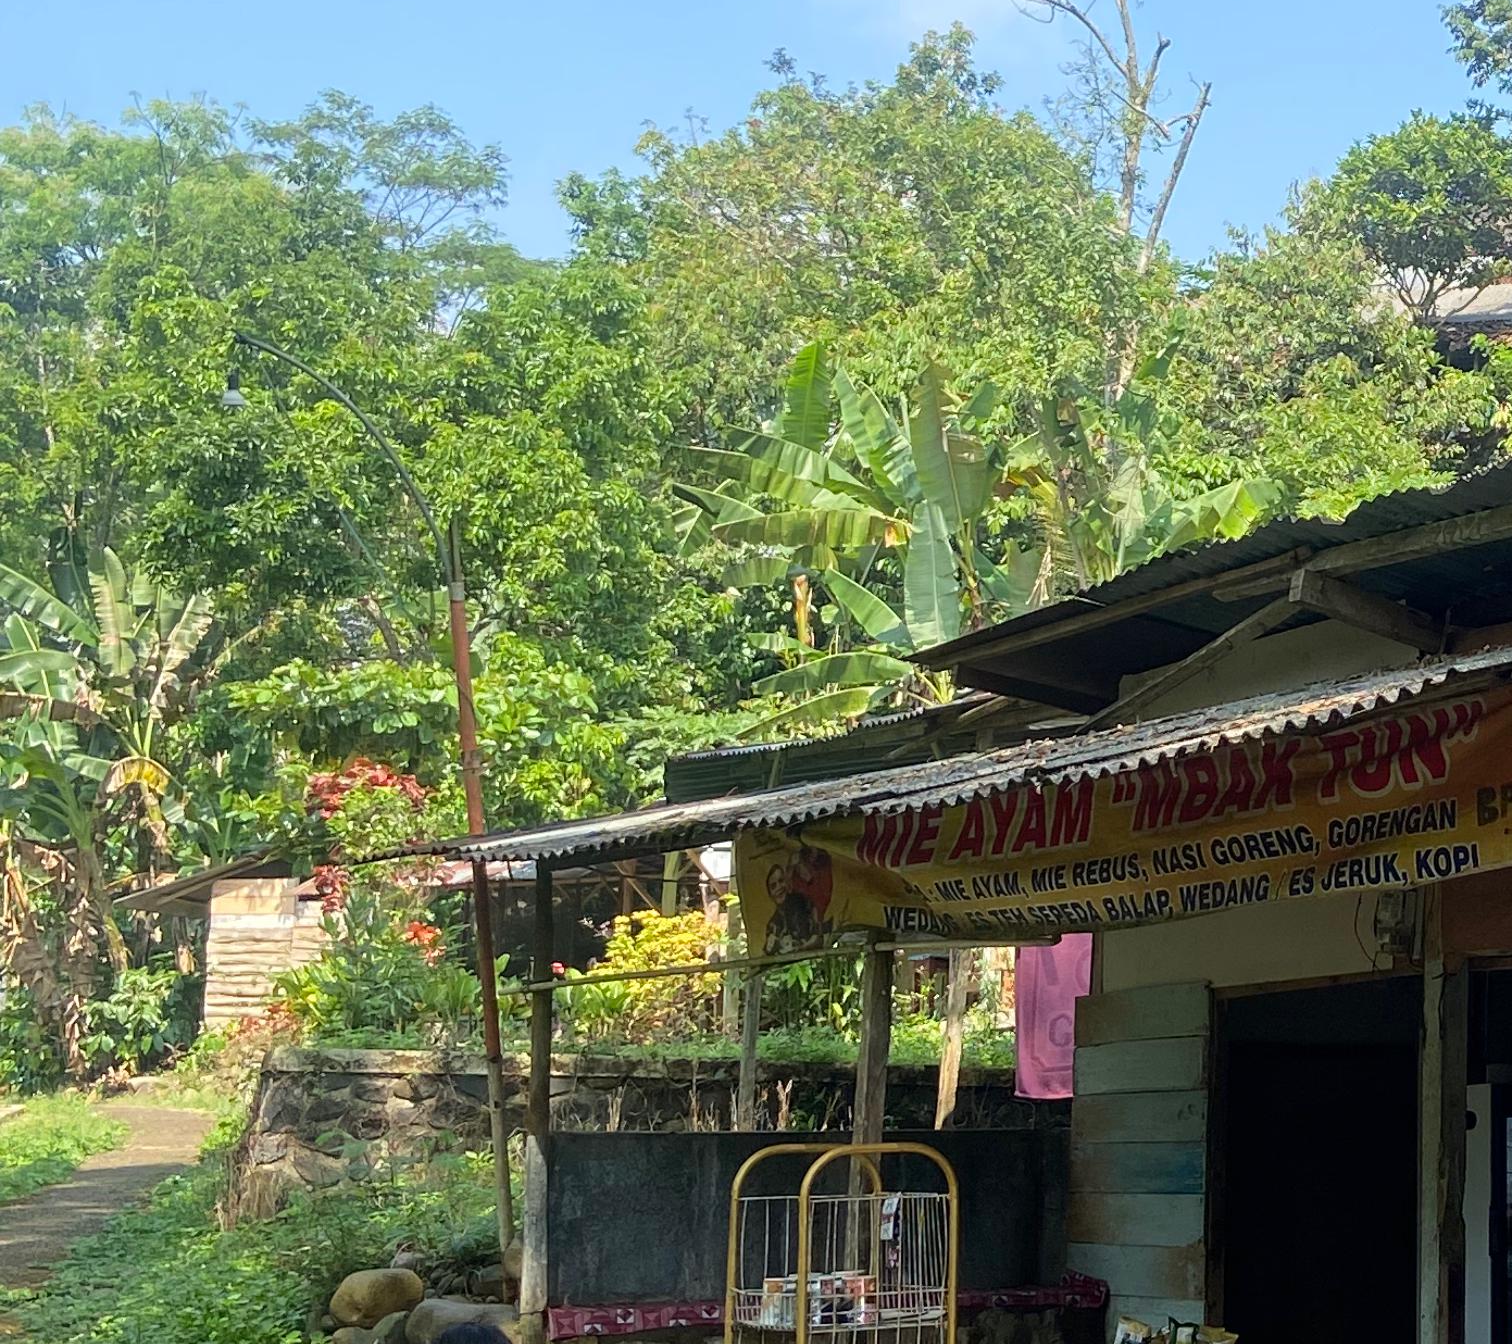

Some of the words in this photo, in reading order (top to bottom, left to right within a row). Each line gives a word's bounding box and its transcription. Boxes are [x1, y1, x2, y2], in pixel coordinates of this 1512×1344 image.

[857, 806, 943, 868] MIE
[950, 774, 1094, 861] AYAM
[934, 879, 972, 902] MIE
[972, 871, 1028, 899] AYAM,
[1031, 864, 1067, 893] MIE
[1073, 854, 1149, 886] REBUS,
[1153, 844, 1206, 875] NASI
[1211, 826, 1320, 865] GORENG,
[1329, 801, 1456, 847] GORENGAN
[1031, 899, 1100, 926] SEPEDA
[1180, 876, 1271, 913] WEDANG
[1289, 867, 1315, 896] ES
[1321, 853, 1408, 891] JERUK,
[1416, 843, 1479, 879] KOPI
